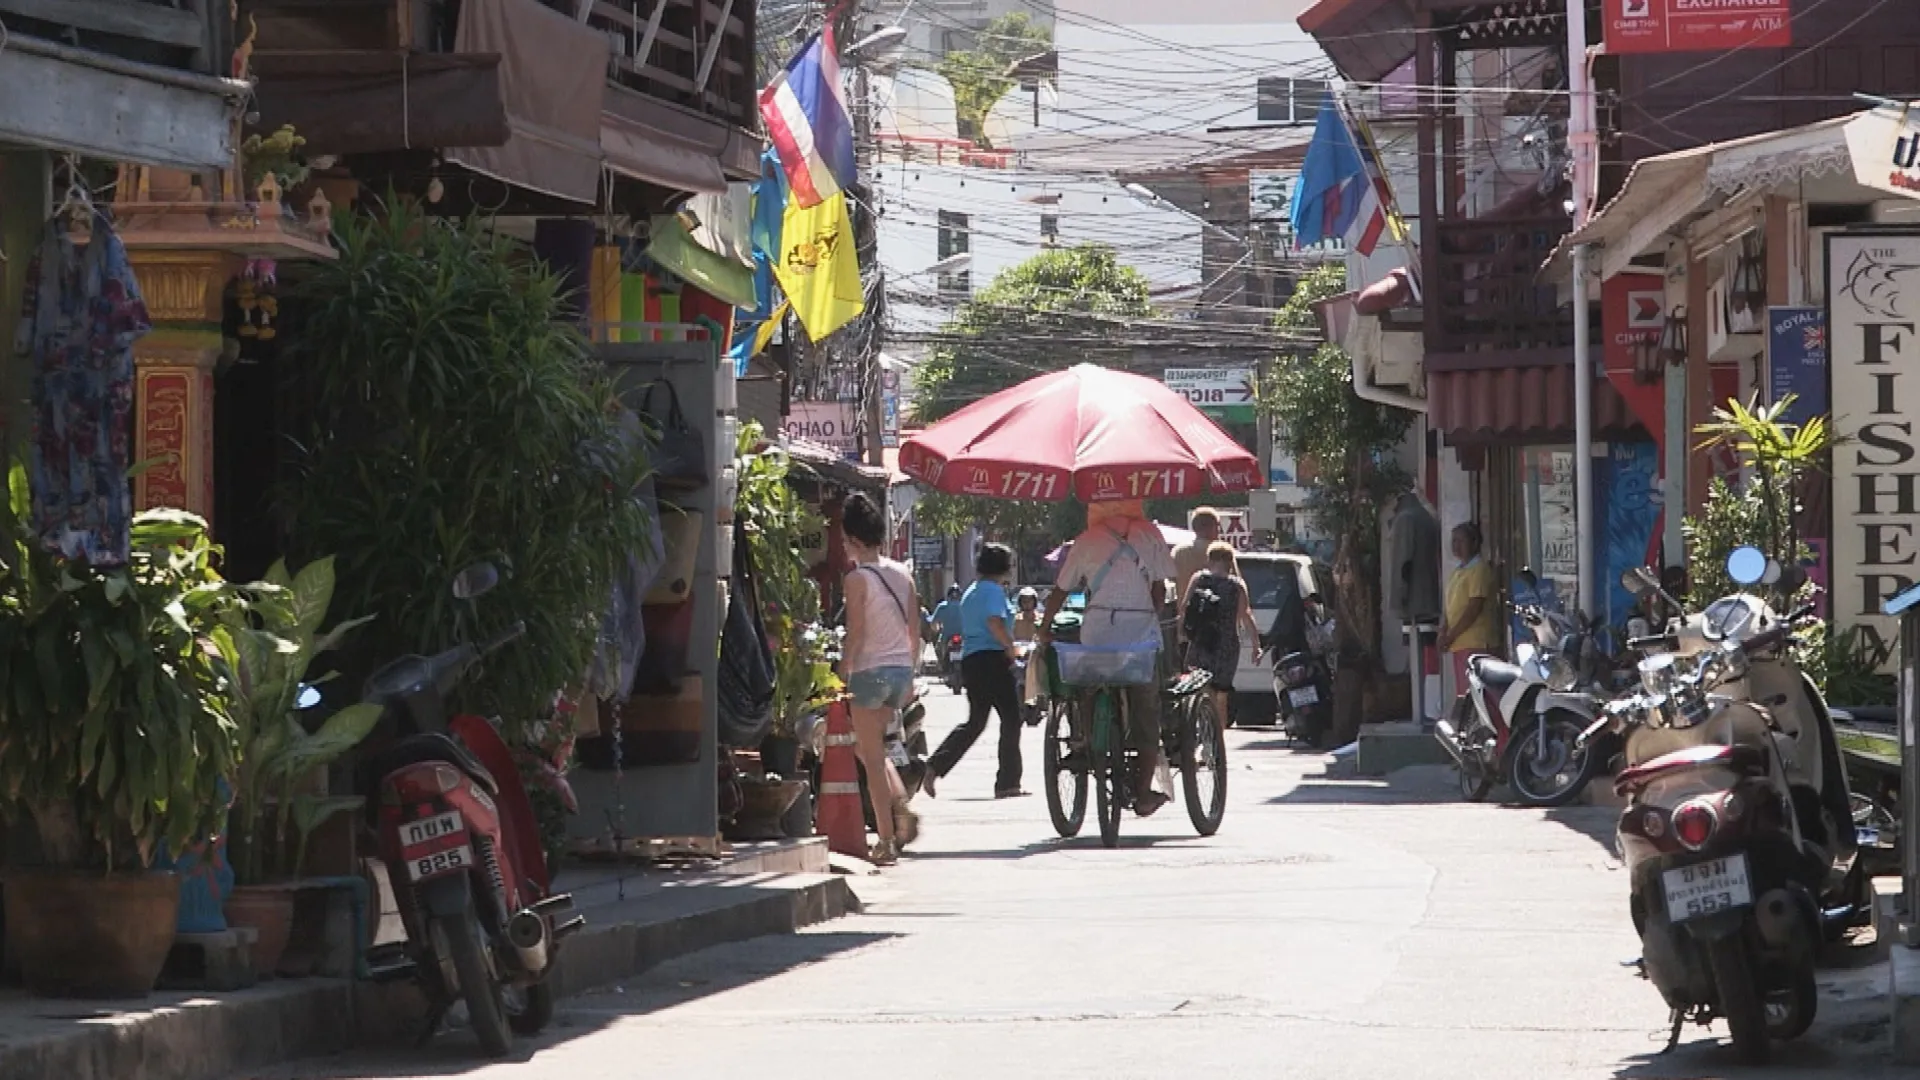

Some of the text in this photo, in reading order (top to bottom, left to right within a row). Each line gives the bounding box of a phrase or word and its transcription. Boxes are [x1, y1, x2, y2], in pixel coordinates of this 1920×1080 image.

[1752, 17, 1782, 31] ATM
[1872, 248, 1897, 258] THE
[1775, 312, 1814, 335] ROYAL
[786, 420, 836, 438] CHAO
[1001, 469, 1057, 498] 1711
[1127, 468, 1186, 497] 1711
[418, 849, 462, 875] 825
